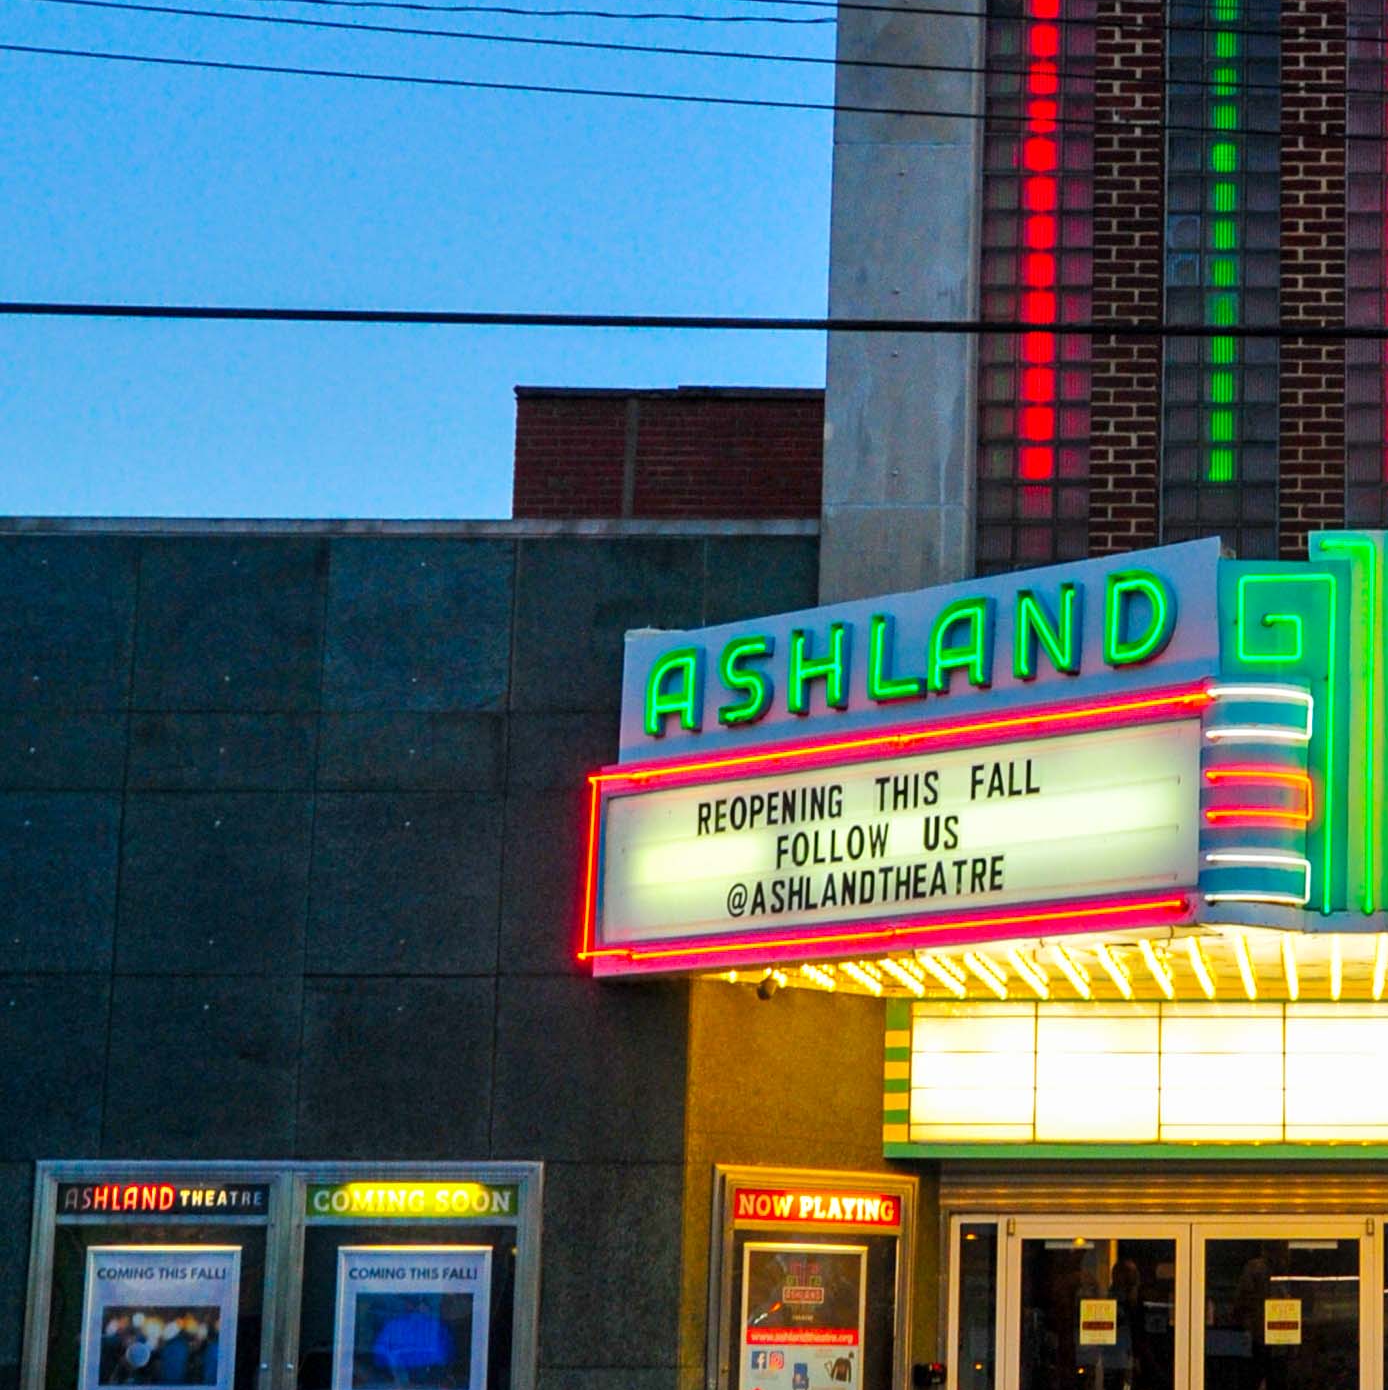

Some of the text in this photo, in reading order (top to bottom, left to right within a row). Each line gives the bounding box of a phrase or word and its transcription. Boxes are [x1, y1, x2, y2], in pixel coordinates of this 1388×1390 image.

[644, 569, 1178, 736] ASHLAND
[697, 759, 1041, 836] REOPENING THIS FALL
[776, 815, 959, 869] FOLLOW US
[727, 855, 1004, 918] @ASHLANDTHEATRE
[64, 1184, 263, 1211] ASHLAND THEATRE
[313, 1189, 512, 1212] COMING SOON
[738, 1193, 895, 1222] NOW PLAYING
[97, 1266, 226, 1280] COMING THIS FALL!
[348, 1266, 478, 1280] COMING THIS FALL!
